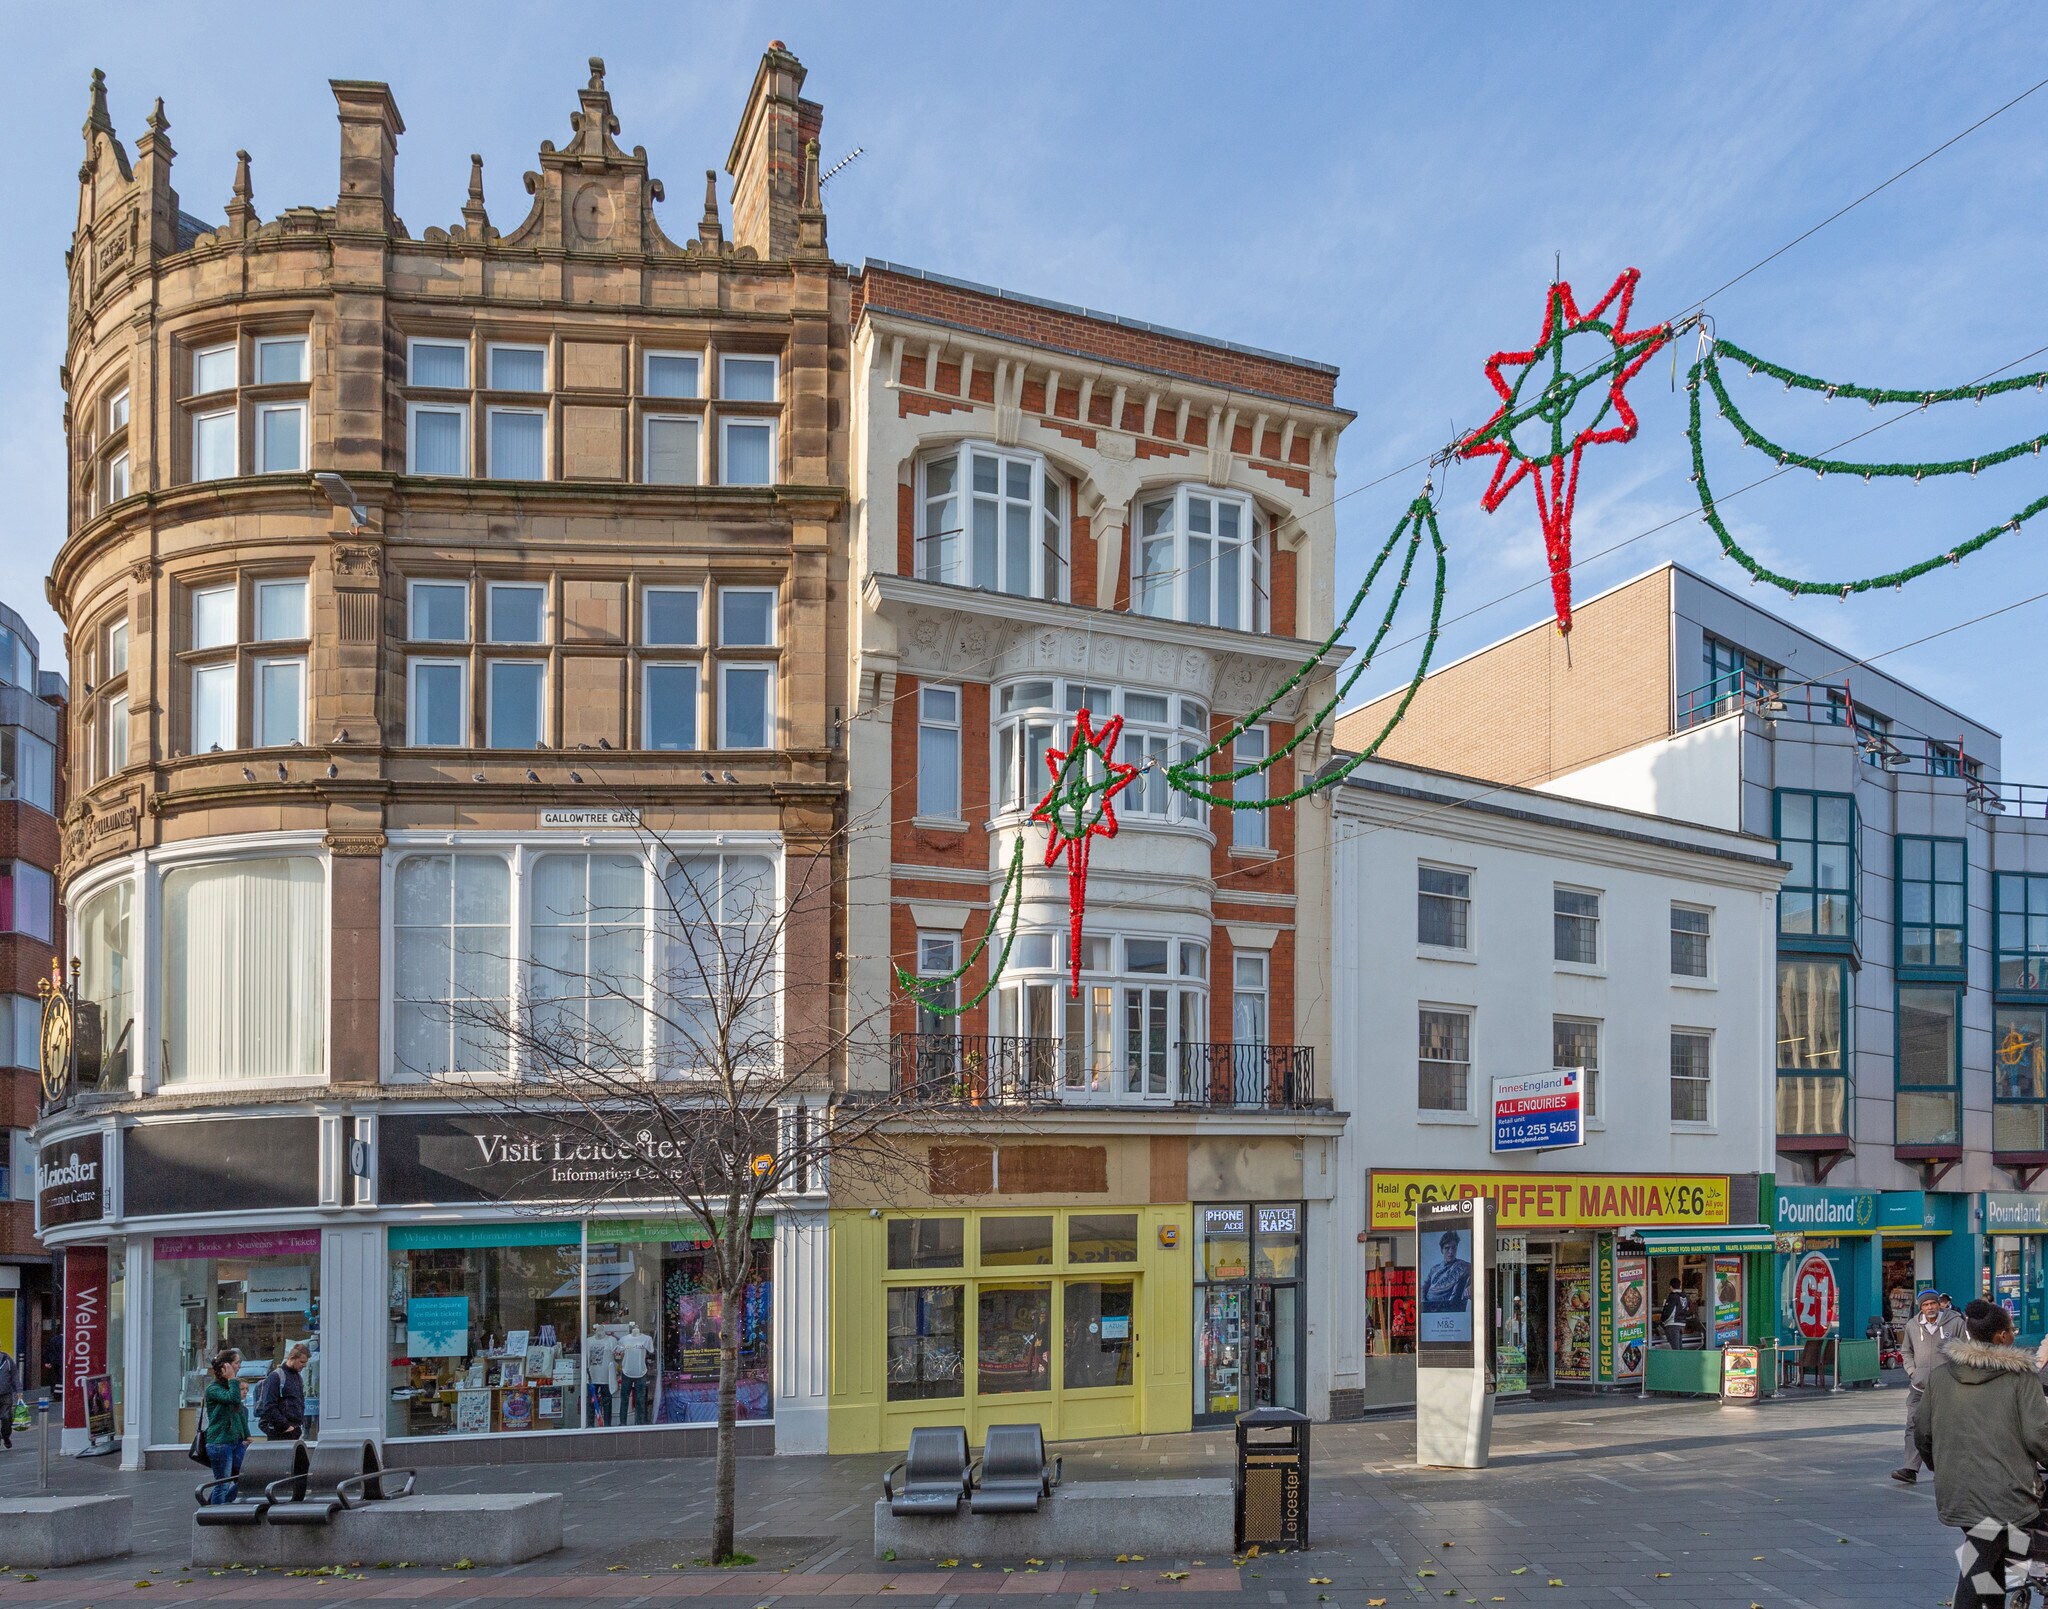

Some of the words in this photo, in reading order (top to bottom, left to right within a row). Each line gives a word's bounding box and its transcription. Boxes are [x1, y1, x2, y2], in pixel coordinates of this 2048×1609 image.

[545, 813, 608, 823] GALLOWTREE
[611, 813, 635, 823] GATE
[1498, 1078, 1562, 1093] InnesEngland
[1498, 1102, 1516, 1114] ALL
[1518, 1096, 1567, 1112] ENQUIRIES
[1498, 1126, 1524, 1138] 0116
[1527, 1124, 1547, 1136] 255
[1550, 1121, 1577, 1134] 5455
[474, 1133, 543, 1162] Visit
[552, 1167, 632, 1182] Information
[1377, 1183, 1399, 1194] Halal
[1376, 1200, 1386, 1208] All
[1387, 1202, 1400, 1211] you
[1579, 1185, 1664, 1217] MANIA
[1678, 1185, 1704, 1216] £6
[1713, 1201, 1723, 1209] you
[1432, 1204, 1458, 1213] InLinkUK
[1778, 1196, 1855, 1223] Poundland
[1989, 1201, 2041, 1222] Poundland
[1207, 1211, 1242, 1221] PHONE
[1260, 1210, 1294, 1220] WATCH
[592, 1228, 624, 1237] Tickets
[642, 1226, 668, 1235] Travel
[1261, 1220, 1293, 1232] RAPS
[404, 1232, 436, 1242] What's
[437, 1232, 452, 1241] On
[471, 1231, 521, 1241] Information
[540, 1229, 567, 1238] Books
[160, 1243, 183, 1252] Travel
[199, 1241, 221, 1250] Books
[237, 1239, 273, 1249] Souvenirs
[289, 1237, 317, 1247] Tickets
[1217, 1267, 1244, 1276] OPEN
[1619, 1268, 1643, 1278] CHICKEN
[1601, 1259, 1612, 1302] LAND
[281, 1296, 297, 1304] Skyline
[415, 1301, 437, 1309] Jubilee
[438, 1301, 462, 1310] Square
[1800, 1274, 1829, 1327] £1
[440, 1310, 462, 1318] tickets
[1437, 1320, 1455, 1329] M&S
[74, 1286, 98, 1388] Welcome
[1620, 1327, 1643, 1337] FALAFEL
[1717, 1331, 1738, 1340] CHICKEN
[1601, 1307, 1612, 1375] FALAFEL
[1284, 1468, 1299, 1541] Leicester
